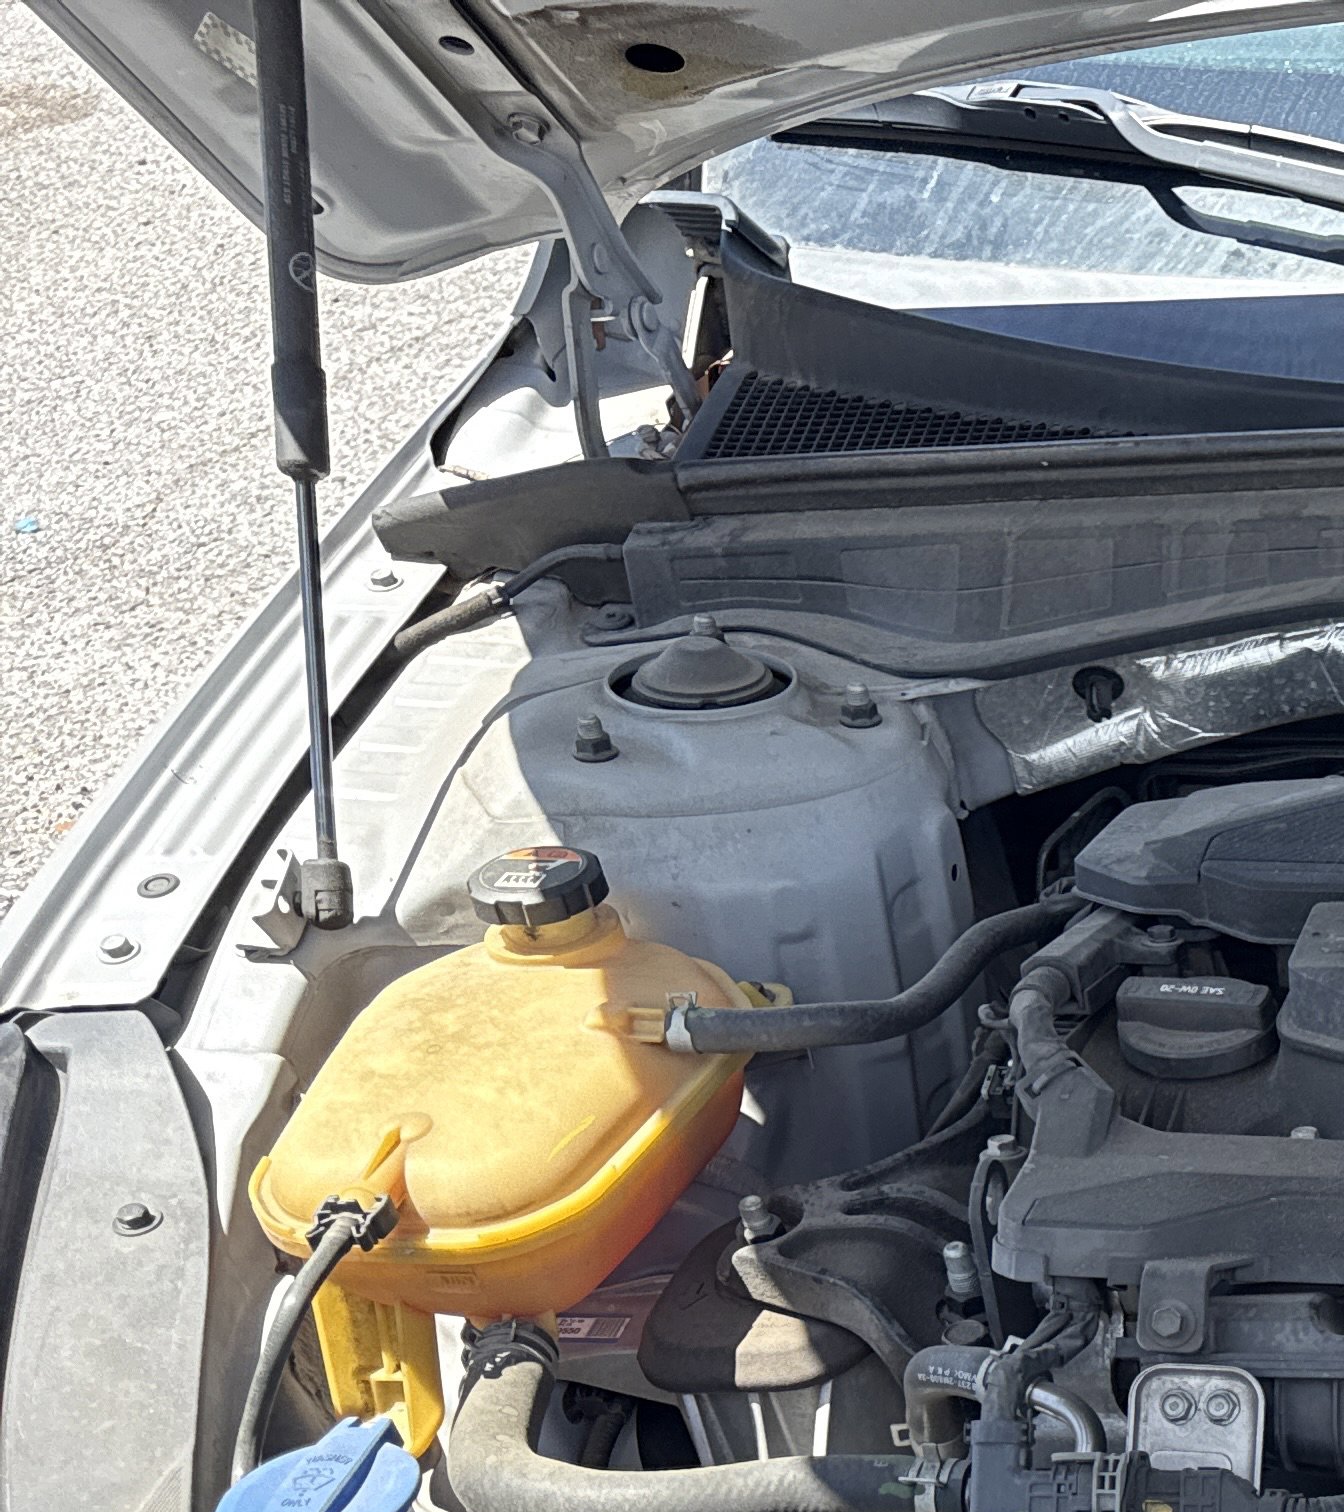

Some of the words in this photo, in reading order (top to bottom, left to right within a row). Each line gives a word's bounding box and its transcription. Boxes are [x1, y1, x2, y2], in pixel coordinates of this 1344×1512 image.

[1159, 983, 1199, 995] 0W-20
[1199, 985, 1226, 997] SAE
[280, 1497, 311, 1507] ONLY
